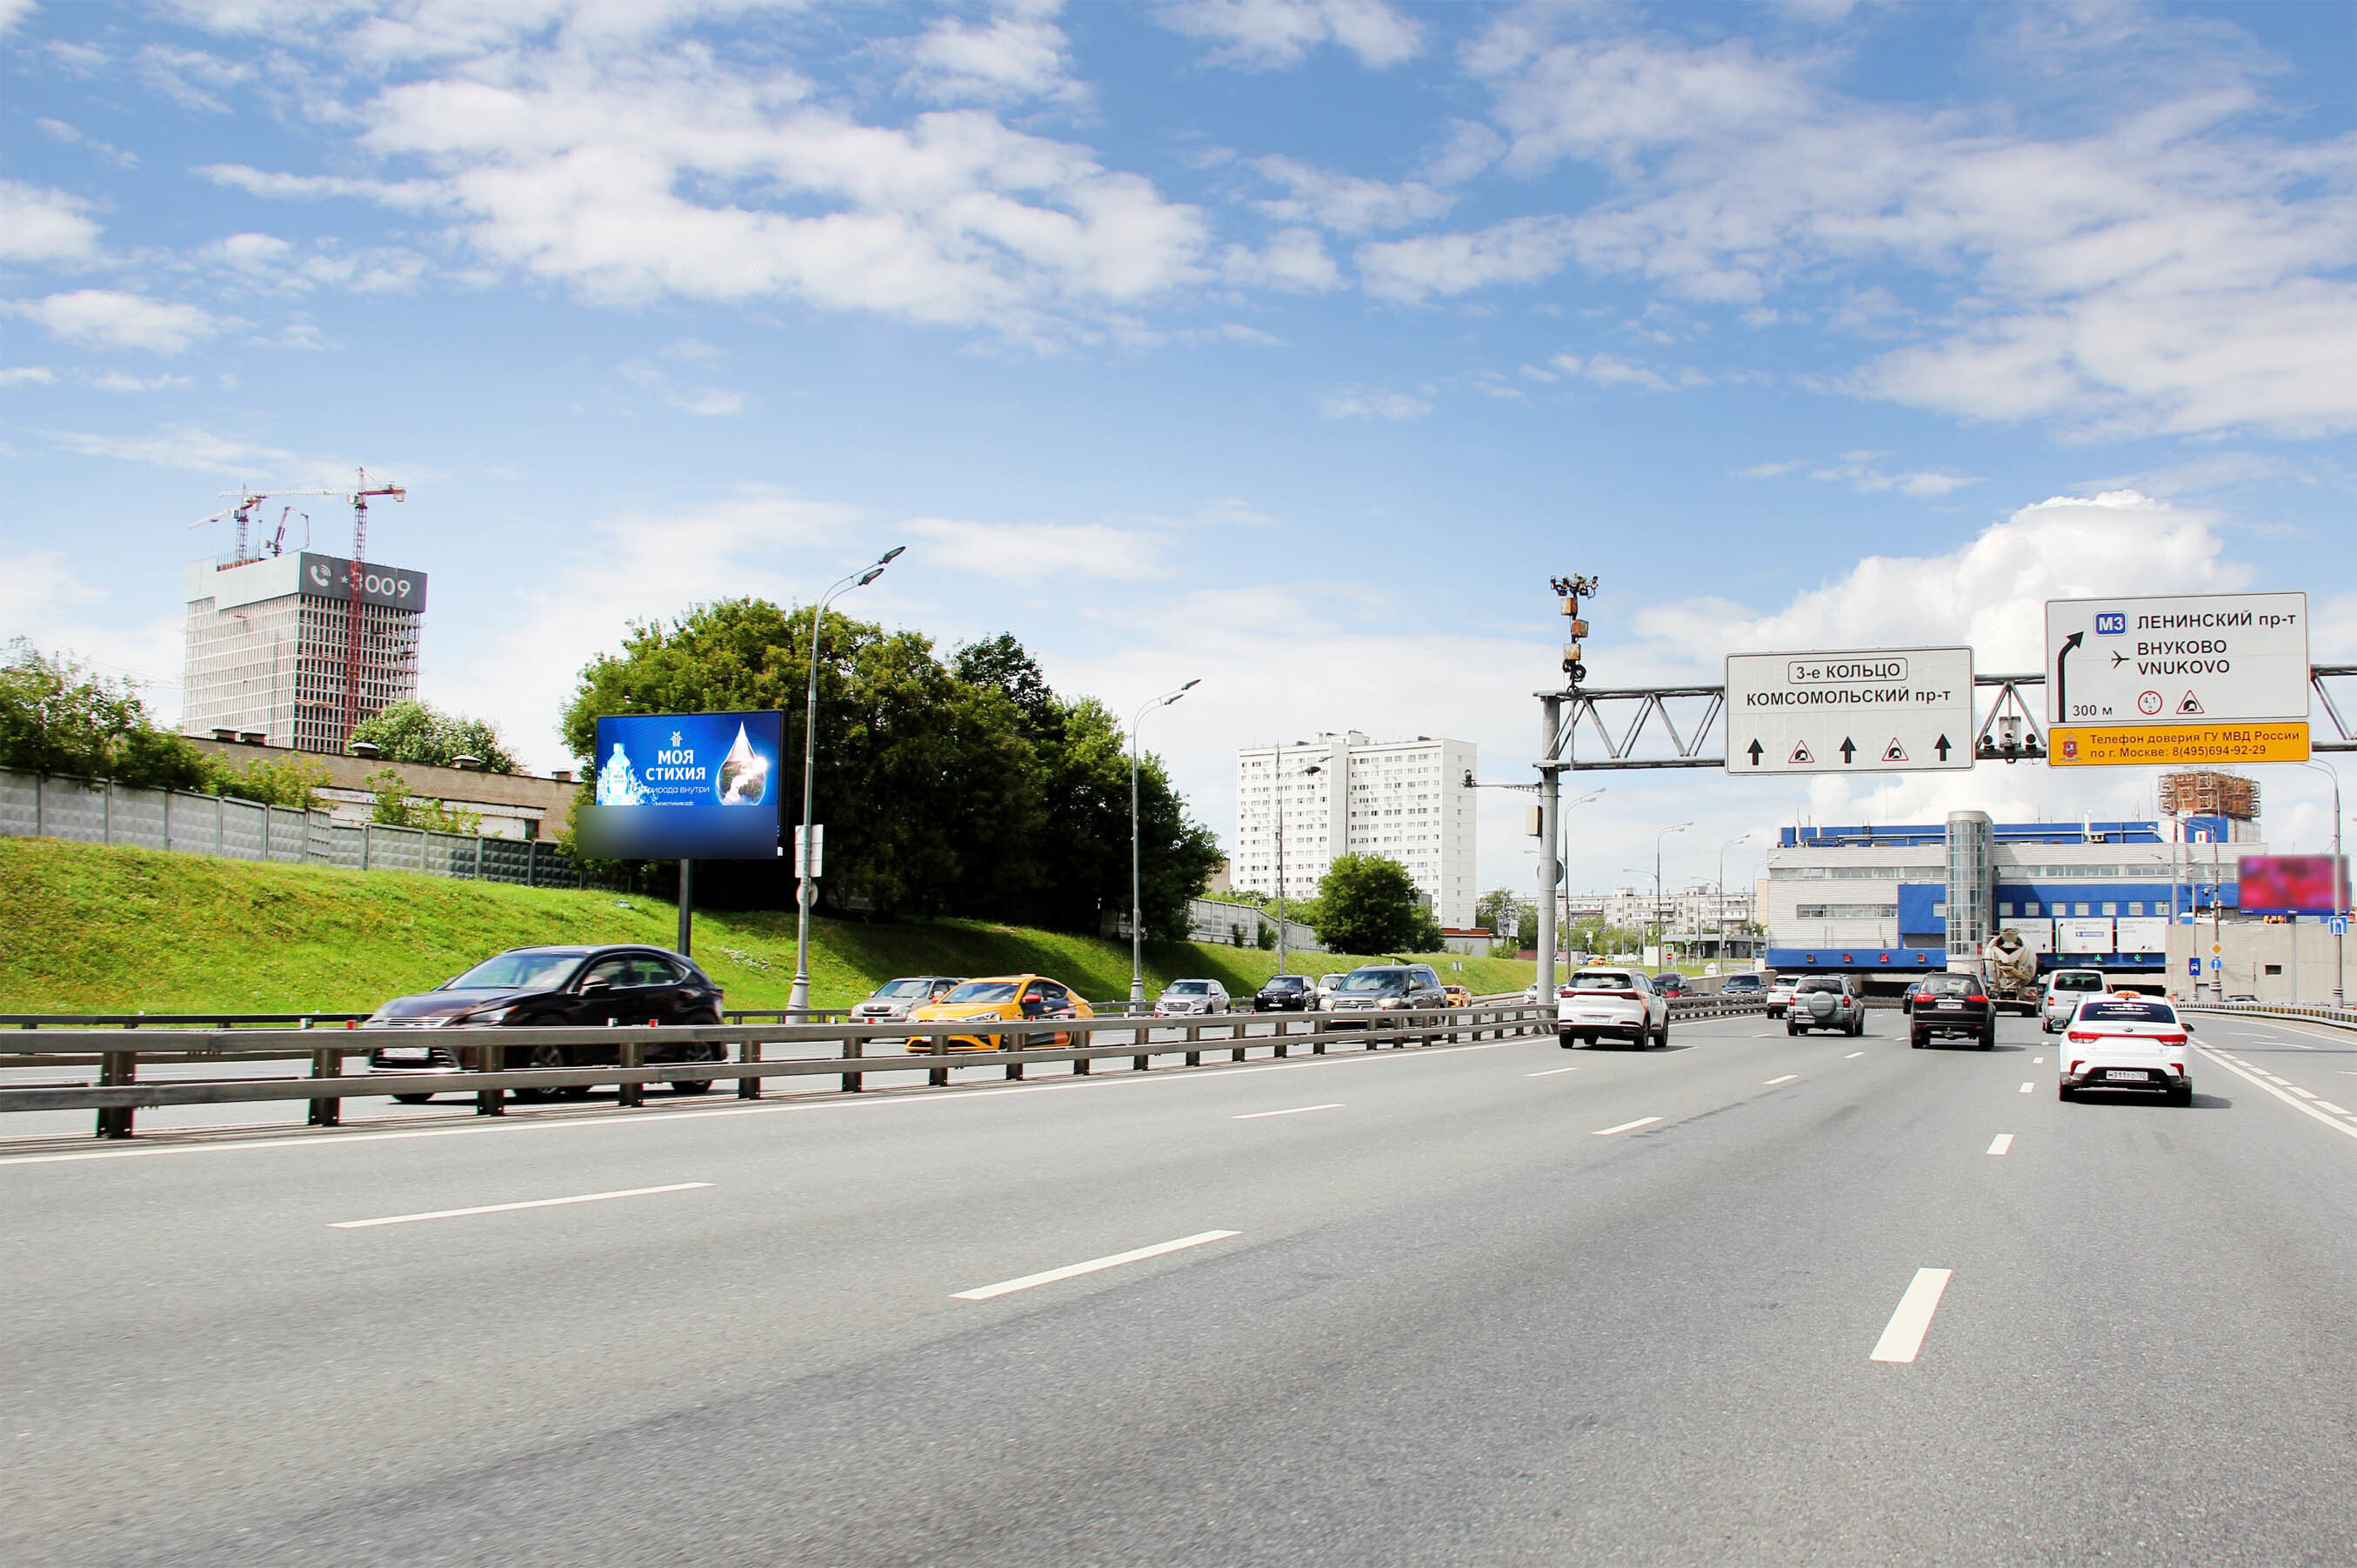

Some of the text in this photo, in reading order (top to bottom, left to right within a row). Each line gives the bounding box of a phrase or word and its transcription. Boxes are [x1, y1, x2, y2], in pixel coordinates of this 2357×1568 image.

[2098, 617, 2125, 631] М3
[2137, 610, 2297, 629] ЛЕНИНСКИЙ пр-т
[2137, 640, 2227, 656] ВНУКОВО
[1796, 663, 1901, 679] 3-е КОЛЬЦО
[2137, 659, 2230, 676] VNUKOVO
[1746, 684, 1952, 706] КОМСОМОЛЬСКИЙ пр-т
[2073, 705, 2113, 717] 300 м
[2090, 731, 2300, 744] Телефон доверия ГУ МВД России
[658, 750, 694, 764] МОЯ
[2090, 744, 2267, 758] по г. Москве: 8(495)694-92-29
[645, 767, 706, 781] СТИХИЯ
[679, 786, 710, 795] внутри
